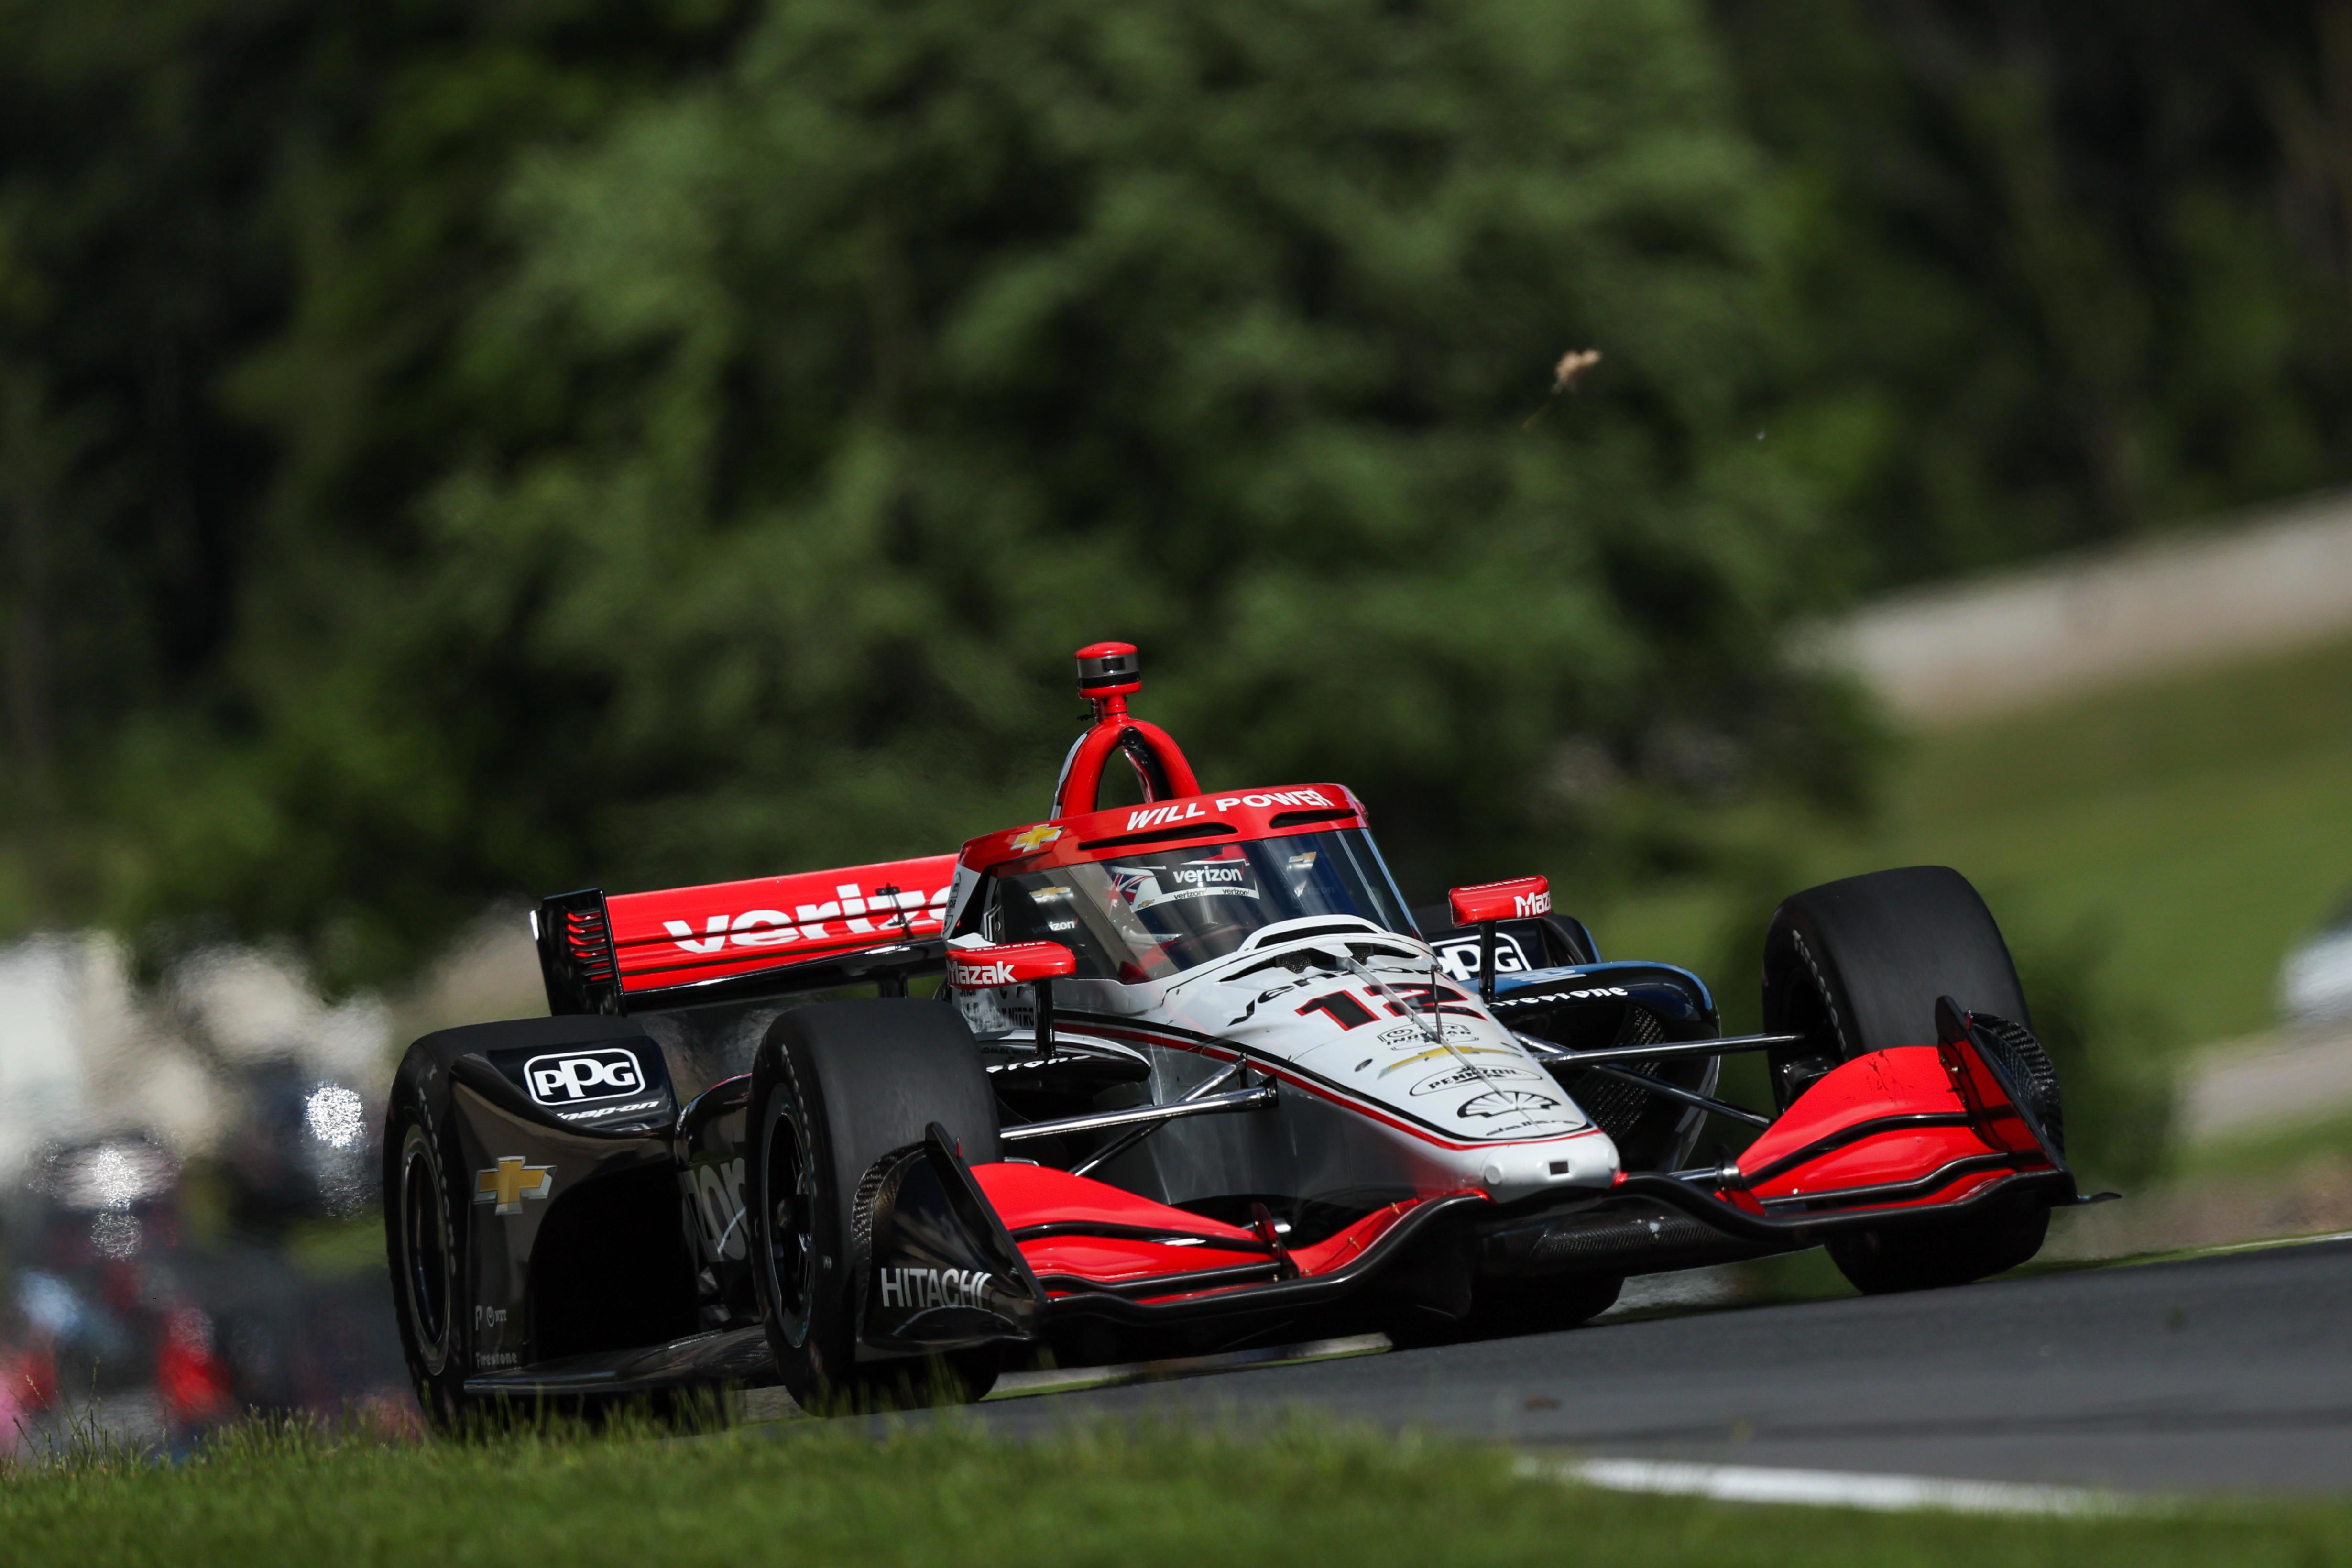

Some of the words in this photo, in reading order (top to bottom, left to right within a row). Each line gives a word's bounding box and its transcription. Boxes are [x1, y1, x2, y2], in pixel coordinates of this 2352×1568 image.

[1127, 803, 1205, 831] WILL
[1216, 790, 1335, 812] POWER
[1173, 866, 1243, 884] verizon
[1174, 889, 1204, 900] verizon
[1222, 888, 1248, 897] verizon
[1514, 892, 1551, 918] Maz
[965, 941, 1047, 953] SIEMENS
[947, 961, 1019, 985] Mazak
[1294, 983, 1489, 1031] 12
[1484, 987, 1628, 1009] irestone
[533, 1058, 637, 1099] PPG
[881, 1268, 992, 1307] HITACHI
